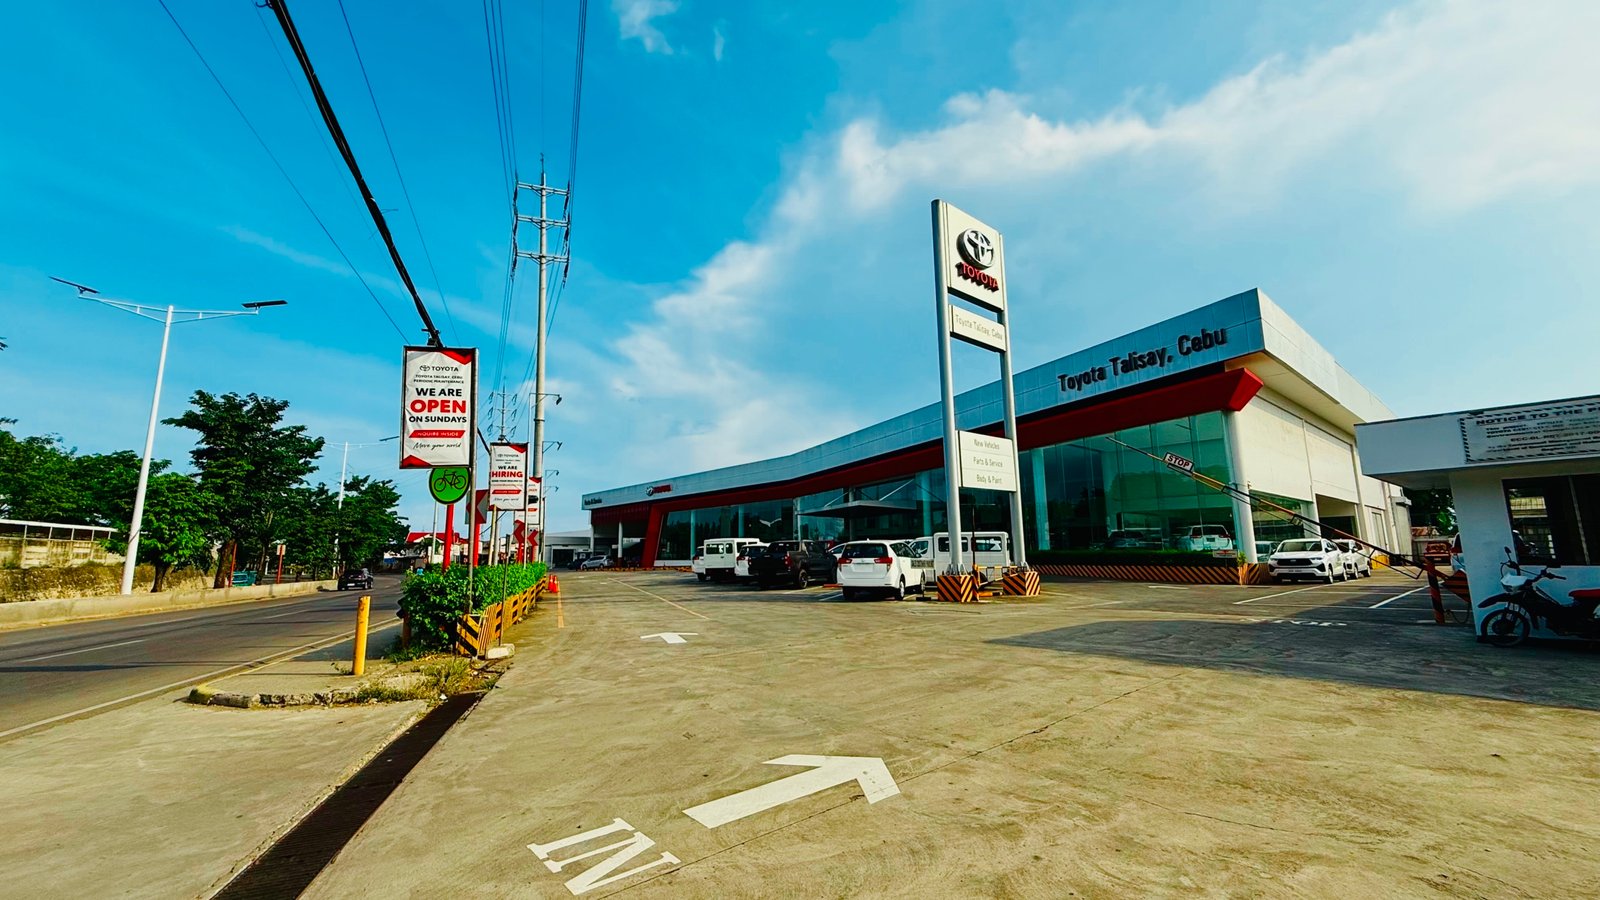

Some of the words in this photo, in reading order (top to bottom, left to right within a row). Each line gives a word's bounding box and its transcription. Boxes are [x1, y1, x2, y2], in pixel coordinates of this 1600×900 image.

[959, 262, 999, 292] TOYOTA
[955, 314, 972, 328] Toyota
[992, 329, 1003, 341] Cebu
[1057, 366, 1107, 392] Toyota
[1177, 328, 1228, 356] Cebu
[416, 388, 436, 396] WE
[439, 388, 462, 396] ARE
[410, 399, 466, 413] OPEN
[1476, 415, 1526, 424] NOTICE
[974, 439, 983, 447] New
[984, 441, 1000, 450] Vehicles
[973, 457, 984, 465] Parts
[989, 459, 1003, 468] Service
[1168, 455, 1190, 468] STOP
[976, 474, 986, 483] Body
[992, 475, 1002, 484] Paint
[526, 817, 681, 896] IN
